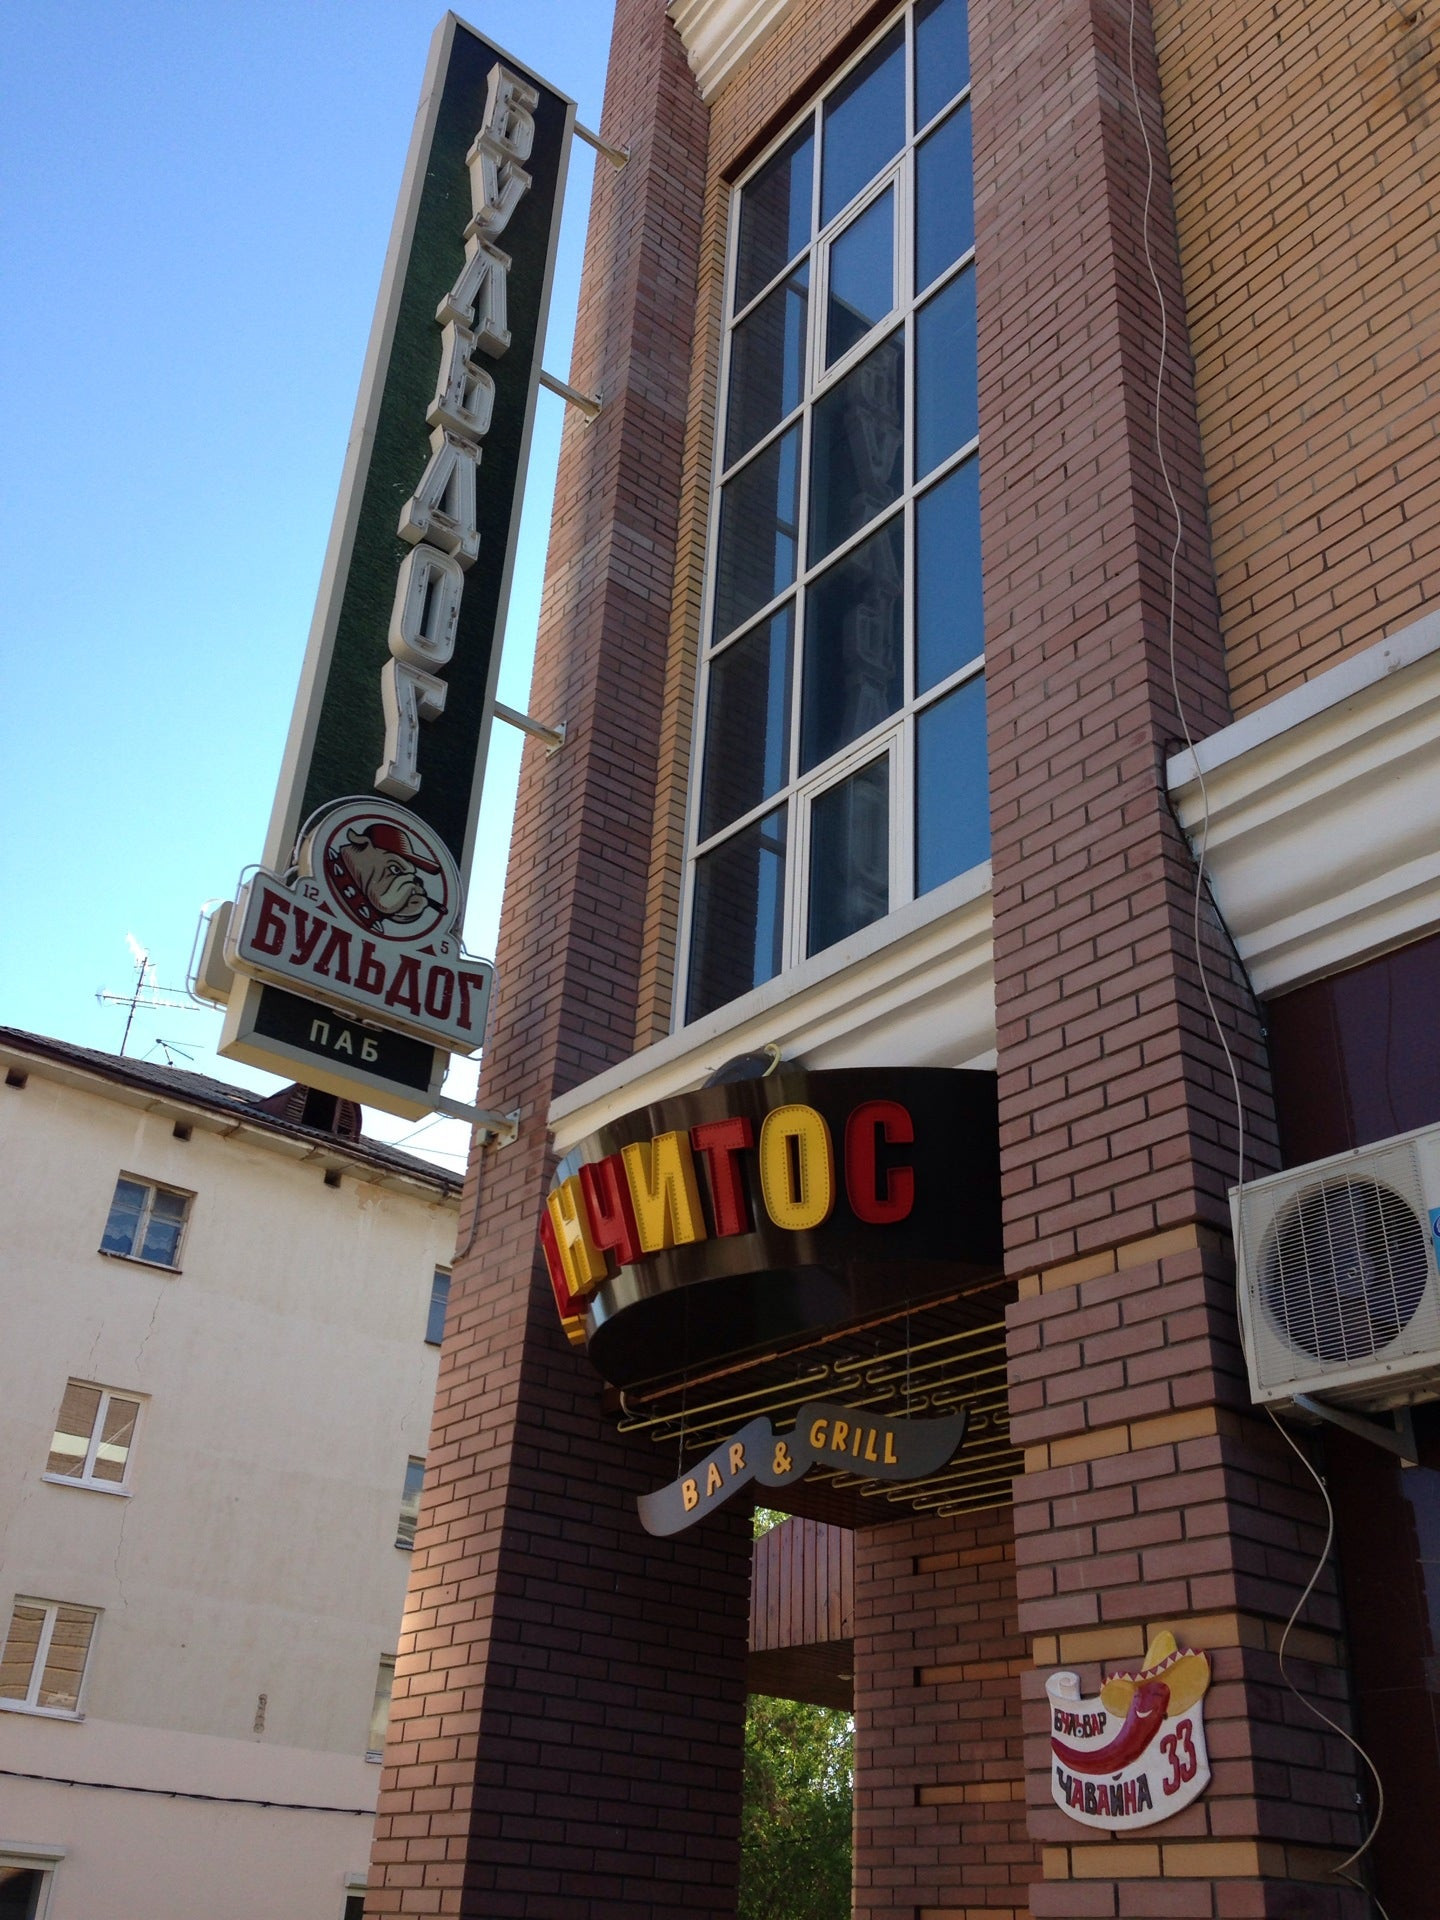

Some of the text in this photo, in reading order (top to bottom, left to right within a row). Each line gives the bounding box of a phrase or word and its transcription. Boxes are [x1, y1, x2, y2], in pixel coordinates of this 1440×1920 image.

[374, 62, 539, 797] БУЛЬДОГ
[302, 884, 320, 901] 12
[250, 887, 484, 1031] БУЛЬДОГ
[440, 941, 449, 953] 5
[309, 1018, 379, 1062] ПАБ
[540, 1100, 914, 1346] НЧИТОС
[681, 1418, 898, 1511] BAR & GRILL
[1054, 1707, 1107, 1739] БУЛЬВАР
[1056, 1718, 1197, 1817] ЧАВАЙНА 33
